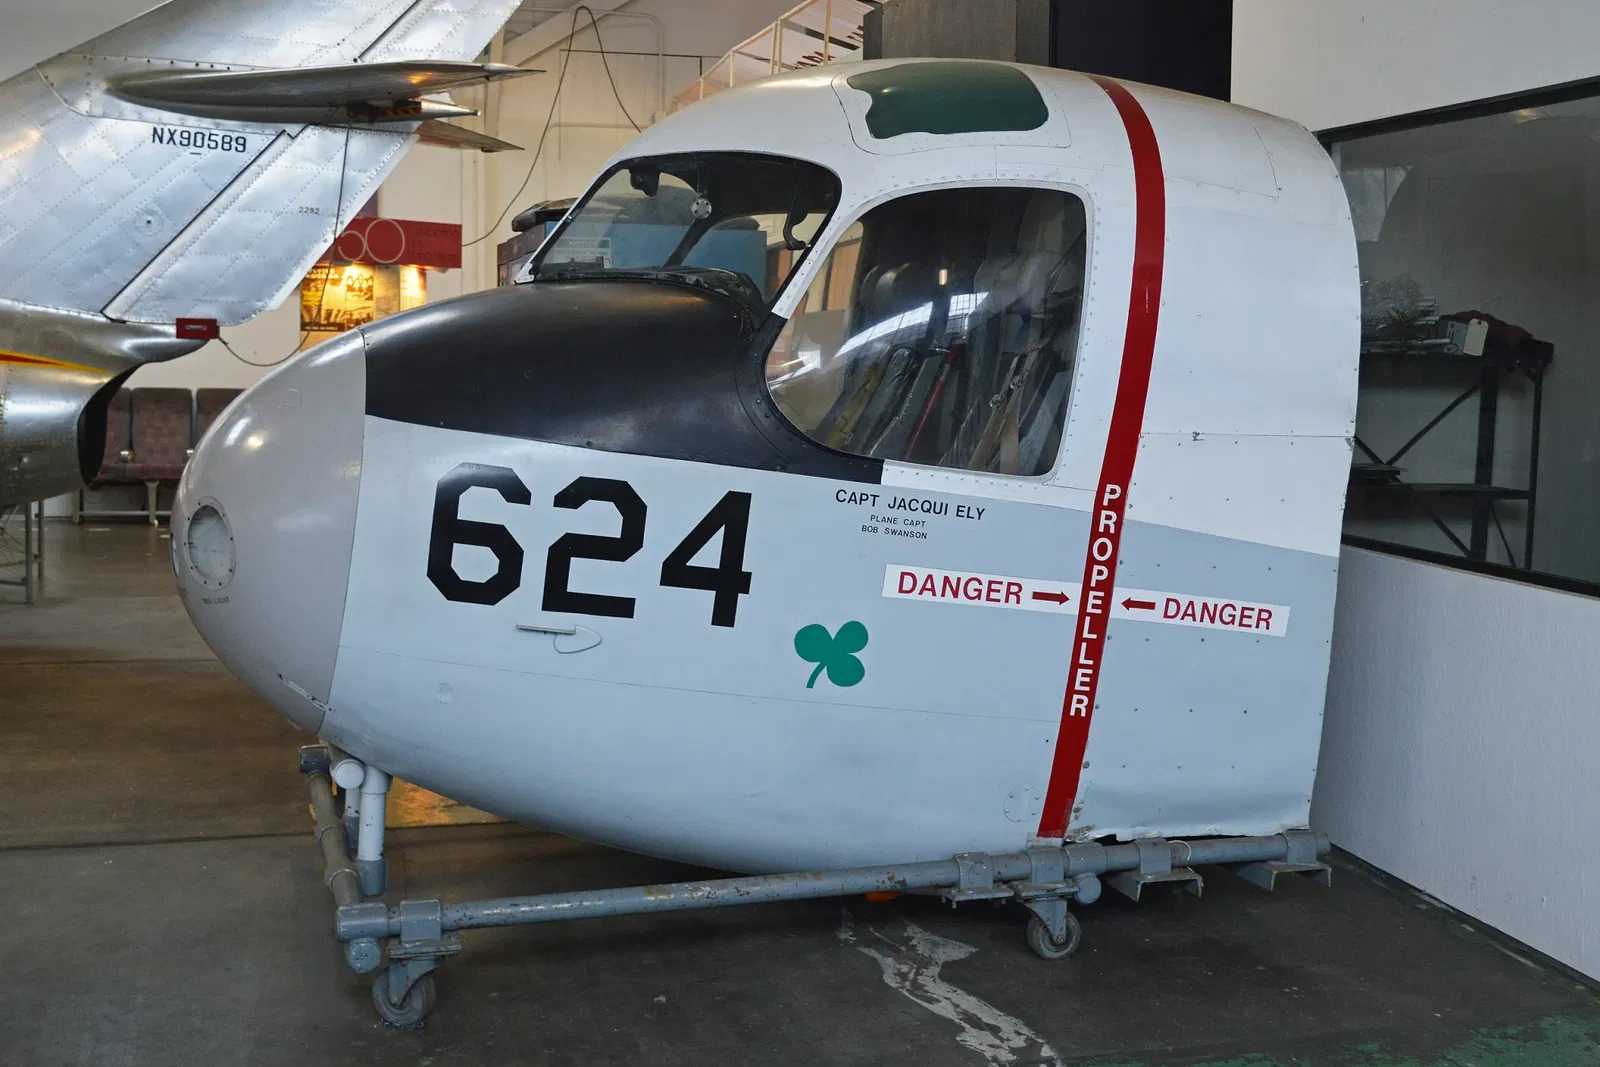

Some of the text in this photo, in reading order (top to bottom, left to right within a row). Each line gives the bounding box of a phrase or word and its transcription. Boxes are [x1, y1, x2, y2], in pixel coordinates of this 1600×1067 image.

[153, 127, 247, 153] NX90589
[298, 206, 320, 215] 2292
[835, 489, 986, 520] CAPT JACQUI ELY
[861, 525, 928, 540] BOB SWANSON
[870, 514, 927, 528] PLANE CAPT
[427, 462, 753, 628] 624
[898, 571, 1023, 605] DANGER
[1069, 483, 1122, 718] PROPELLER
[1163, 598, 1273, 630] DANGER
